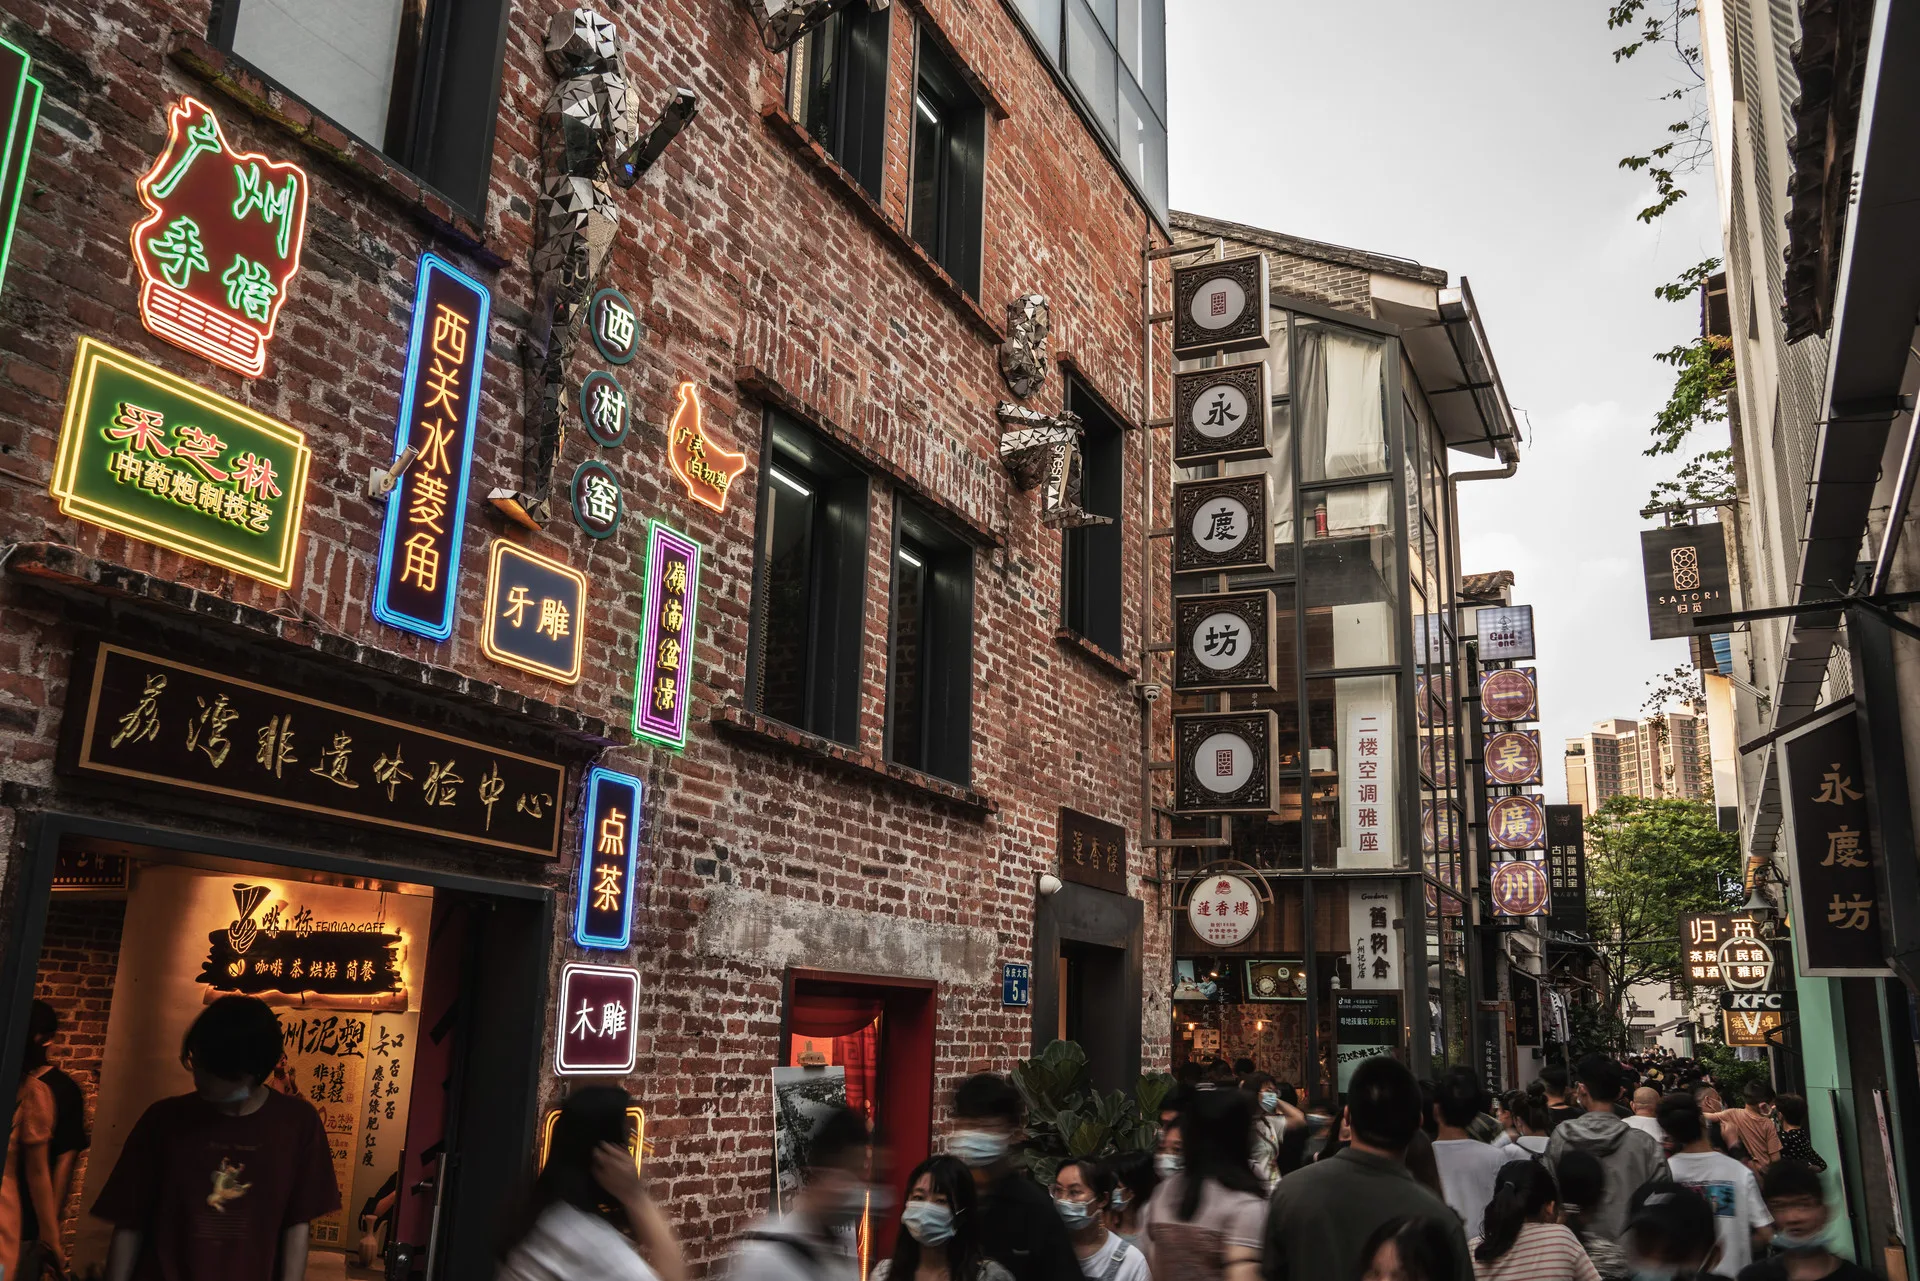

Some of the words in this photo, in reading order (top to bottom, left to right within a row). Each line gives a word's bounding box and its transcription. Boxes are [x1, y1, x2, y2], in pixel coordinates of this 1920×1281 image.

[584, 298, 636, 524] 西村窑
[104, 402, 284, 501] 采芝林
[400, 303, 471, 593] 西关水菱角
[110, 451, 273, 534] 中药炮制技艺
[1201, 392, 1241, 657] 永慶坊
[502, 585, 570, 640] 牙雕
[1658, 590, 1719, 605] SATORI
[1358, 716, 1379, 852] 二楼空调雅座
[592, 807, 628, 912] 点茶
[1811, 763, 1873, 931] 永慶坊
[1197, 900, 1250, 917] 蓮香樓
[255, 958, 283, 977] 咖啡
[289, 957, 303, 978] 茶
[309, 960, 338, 979] 烘焙
[346, 959, 376, 982] 简餐
[1690, 949, 1718, 963] 茶房
[1736, 949, 1764, 962] 民宿
[1691, 966, 1720, 978] 调酒
[1737, 965, 1765, 978] 雅间
[1012, 979, 1019, 1001] 5
[1731, 993, 1782, 1009] KFC
[570, 1002, 628, 1042] 木雕
